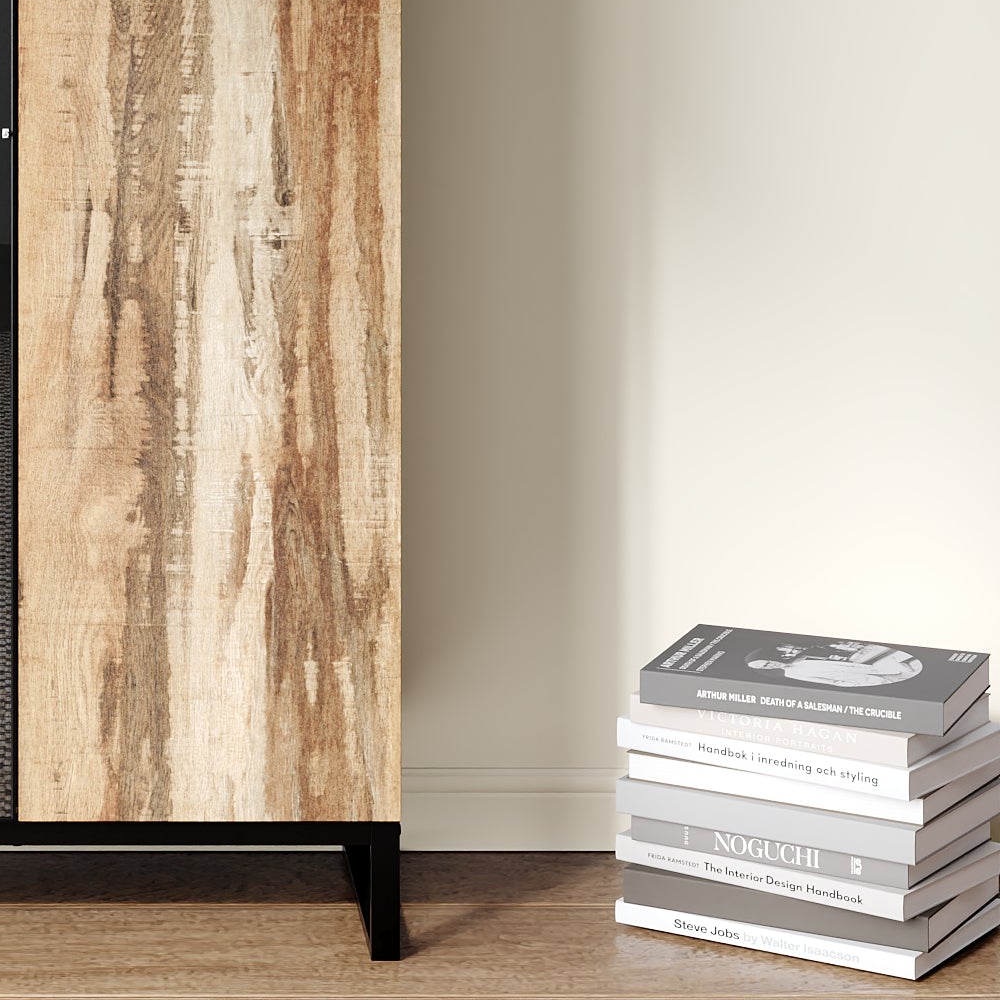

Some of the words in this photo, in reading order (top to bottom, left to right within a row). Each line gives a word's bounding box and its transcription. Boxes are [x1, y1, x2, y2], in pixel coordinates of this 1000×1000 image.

[696, 689, 728, 701] ARTHUR
[728, 692, 757, 704] MILLER
[760, 696, 785, 707] DEATH
[785, 699, 796, 708] OF
[797, 700, 803, 709] A
[804, 701, 843, 714] SALESMAN
[849, 705, 864, 716] THE
[865, 708, 902, 720] CRUCIBLE
[642, 734, 660, 742] FRIDA
[697, 709, 783, 732] VICTORIA
[792, 723, 858, 744] HAGAN
[721, 728, 770, 743] INTERIOR
[776, 737, 833, 753] PORTRAITS
[698, 742, 748, 760] Handbok
[758, 753, 812, 775] inredning
[816, 766, 836, 777] och
[840, 770, 878, 787] styling
[713, 831, 820, 869] NOGUCHI
[647, 852, 666, 862] FRIDA
[667, 856, 700, 869] RAMSTEDT
[704, 862, 723, 874] The
[725, 864, 764, 883] Interior
[766, 875, 803, 893] Design
[806, 884, 863, 905] Handbook
[673, 918, 708, 934] Steve
[710, 926, 740, 940] Jobs
[743, 931, 758, 946] by
[761, 934, 801, 952] Walter
[803, 943, 860, 963] Isaacson
